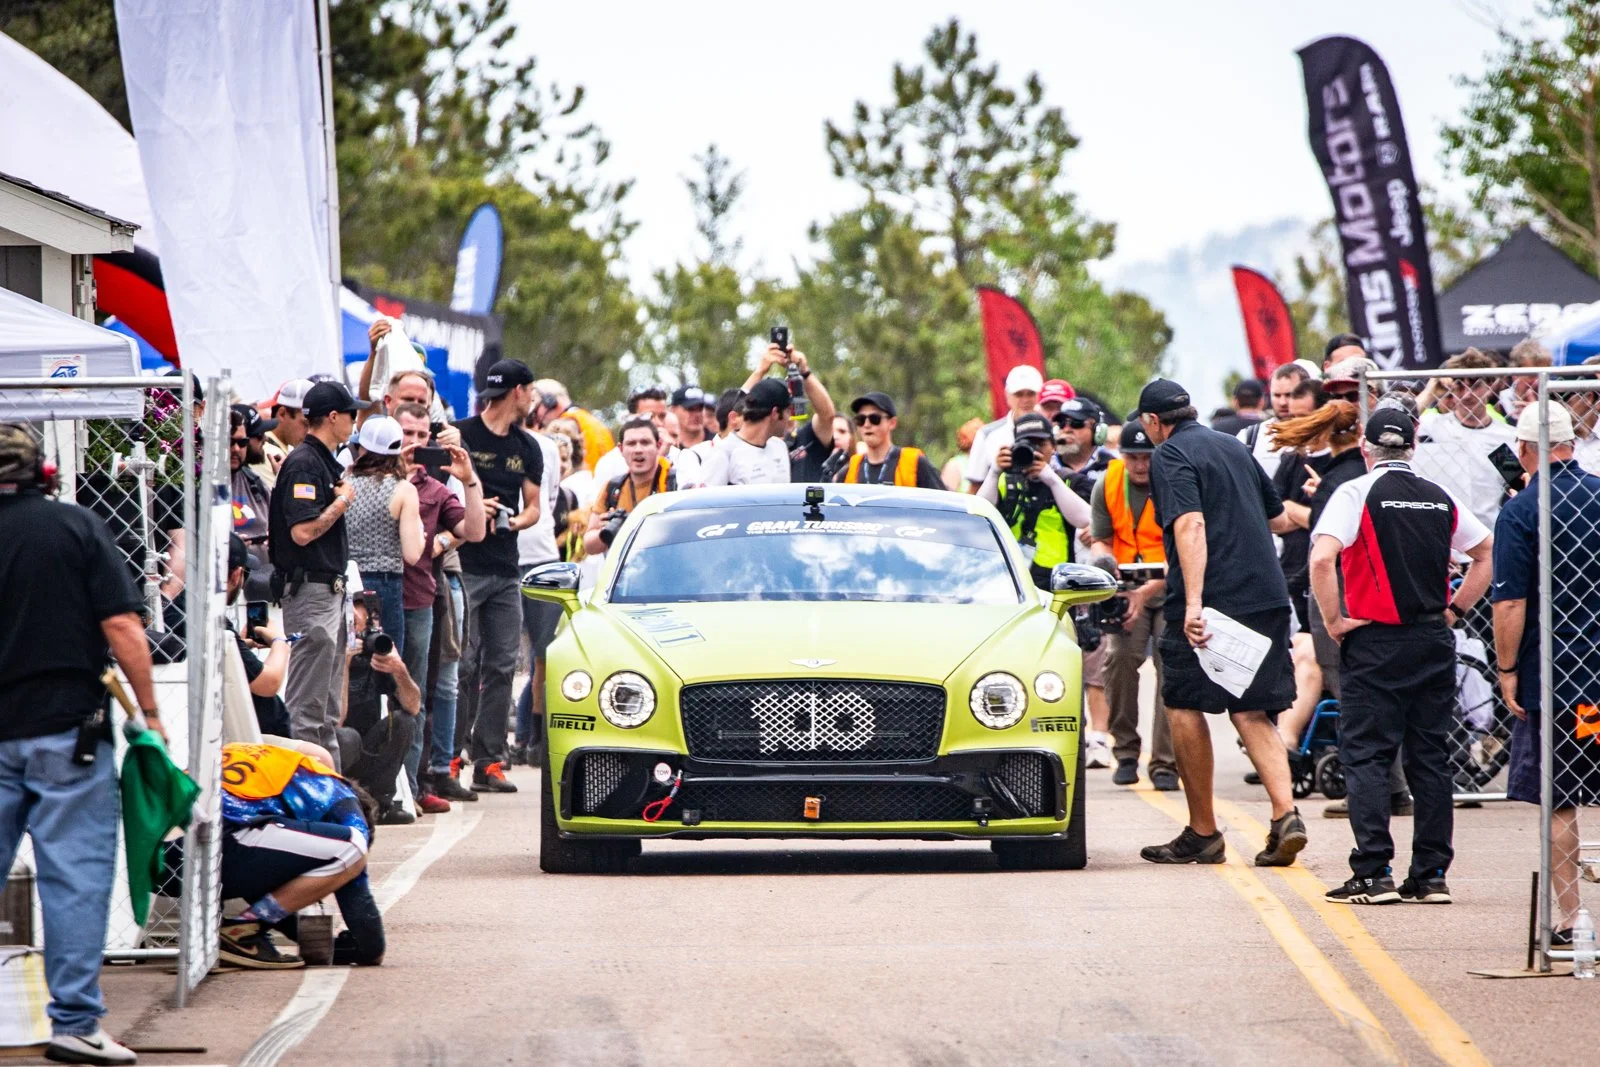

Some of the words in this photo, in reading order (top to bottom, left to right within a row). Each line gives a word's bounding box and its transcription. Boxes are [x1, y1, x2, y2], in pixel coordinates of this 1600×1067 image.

[1323, 75, 1387, 267] Motors
[1386, 178, 1414, 247] Jeep
[1381, 501, 1449, 511] PORSCHE
[747, 520, 800, 530] GRAN
[550, 713, 596, 731] PIRELLI
[1031, 717, 1077, 732] PIRELLI
